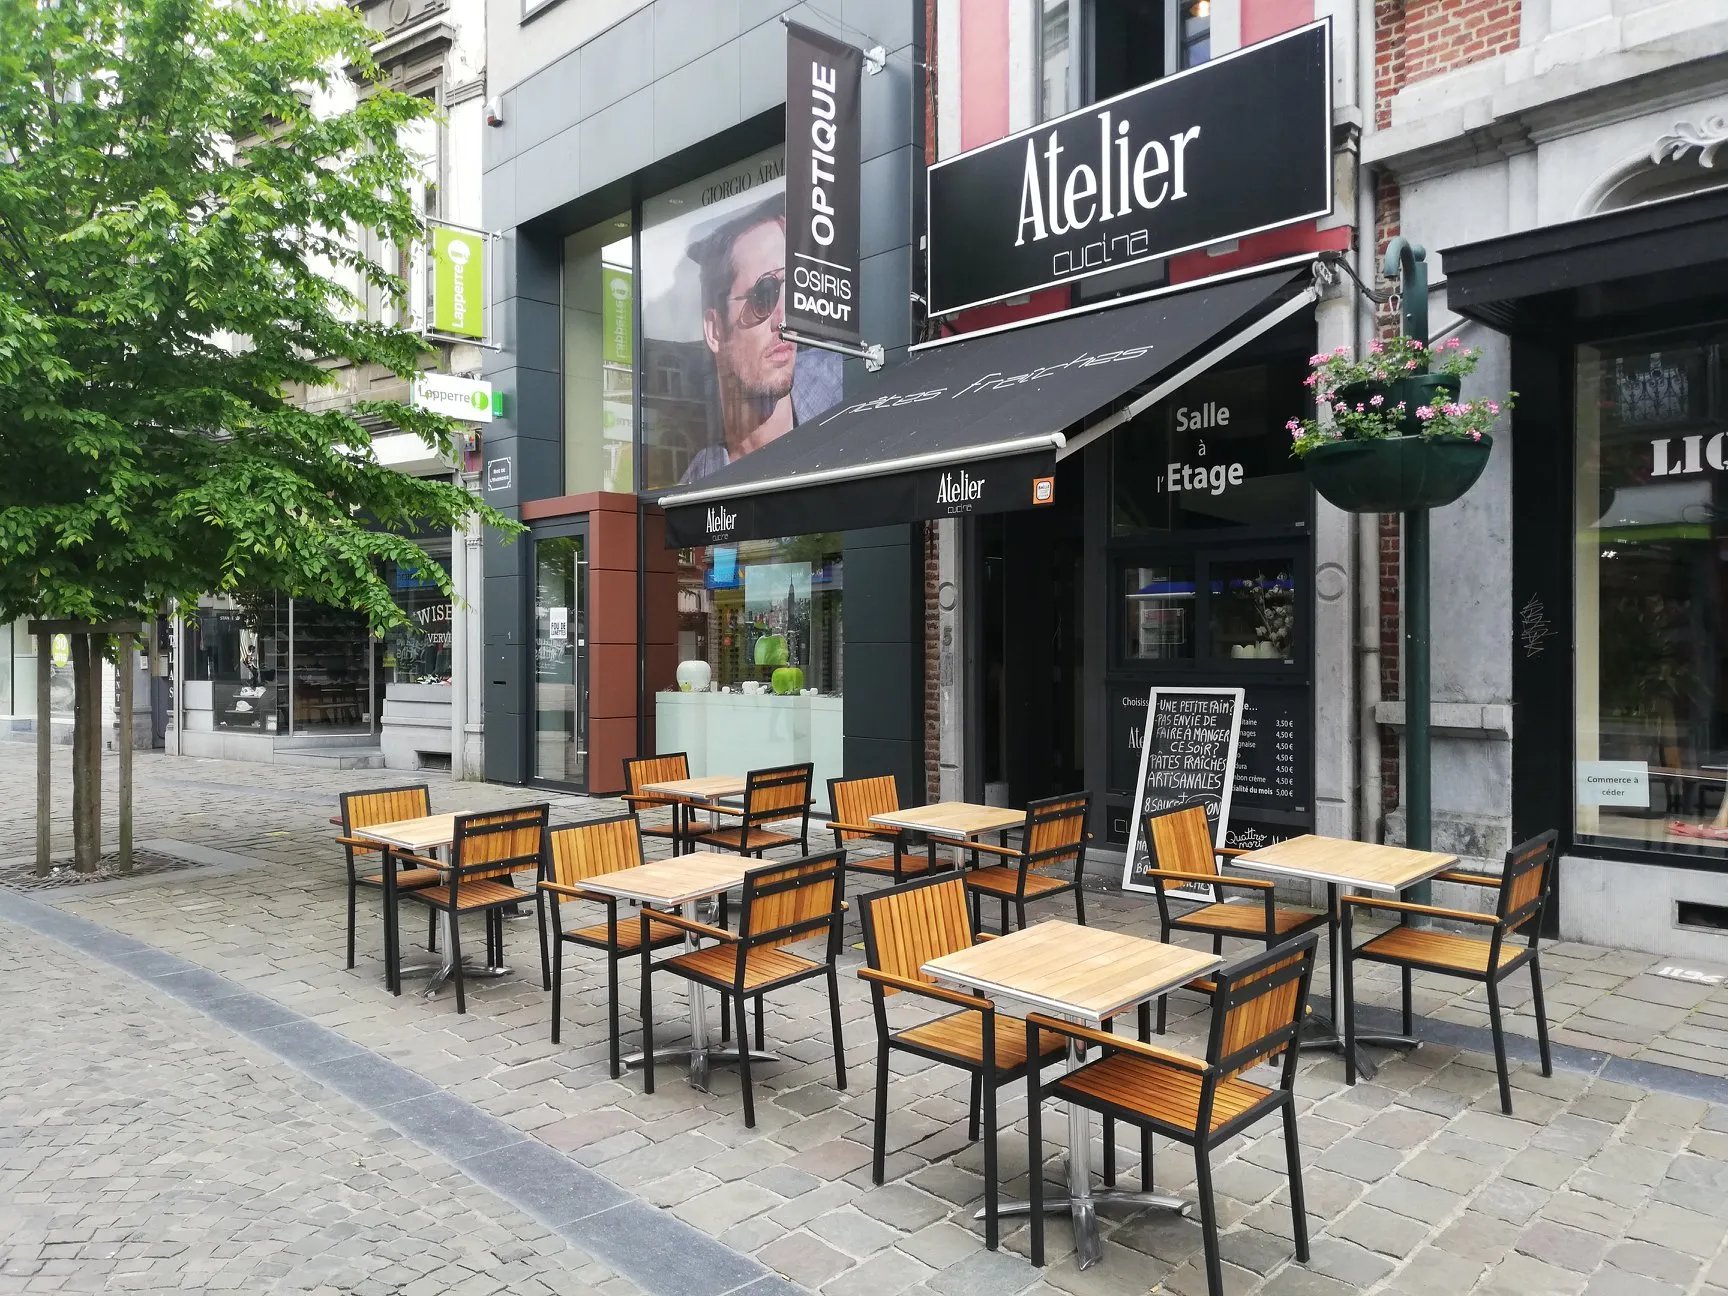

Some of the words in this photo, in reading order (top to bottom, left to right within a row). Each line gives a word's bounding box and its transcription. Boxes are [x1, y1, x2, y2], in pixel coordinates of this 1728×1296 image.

[812, 62, 836, 246] OPTIQUE
[702, 172, 751, 206] GIORGIO
[1015, 111, 1200, 247] Atelier
[1054, 229, 1148, 275] cucina
[452, 264, 466, 329] Lapperre
[794, 267, 851, 299] OSIRIS
[794, 292, 851, 321] DAOUT
[1176, 401, 1230, 431] Salle
[1198, 439, 1206, 456] à
[936, 470, 985, 503] Atelier
[706, 505, 737, 533] Atelier
[1193, 728, 1231, 742] MANGER
[1203, 715, 1217, 727] DE
[1147, 771, 1223, 789] ARTISANALES
[1249, 786, 1258, 794] du
[1258, 787, 1273, 795] mois
[1587, 776, 1632, 784] Commerce
[1633, 776, 1639, 784] à
[1601, 788, 1625, 796] céder
[1226, 828, 1267, 845] Quattro
[1239, 840, 1263, 849] mori
